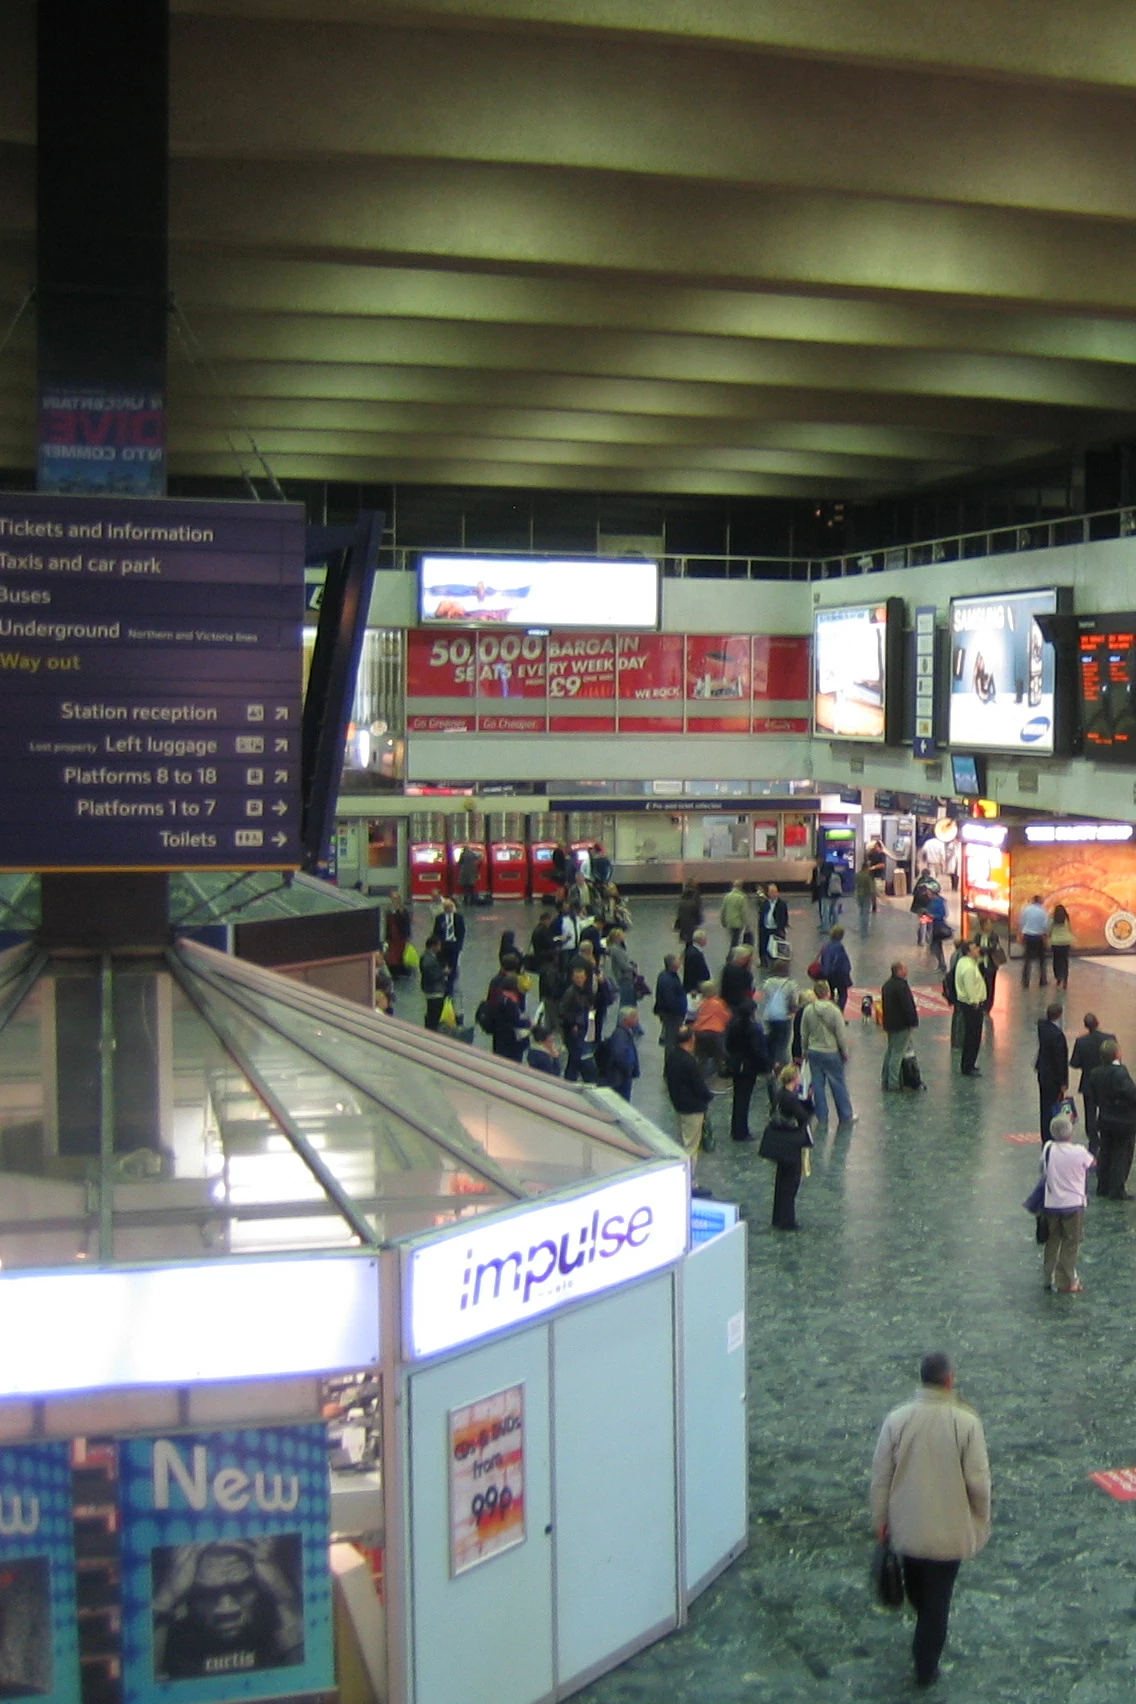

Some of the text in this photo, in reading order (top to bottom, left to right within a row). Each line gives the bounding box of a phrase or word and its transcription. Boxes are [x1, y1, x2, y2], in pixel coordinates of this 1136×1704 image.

[0, 518, 63, 537] Tickets
[68, 522, 102, 538] and
[0, 552, 162, 576] Taxis and car park
[0, 586, 51, 604] Buses
[0, 619, 120, 641] Underground
[430, 636, 640, 667] 50,000 BARGAIN
[0, 653, 81, 674] Way out
[455, 664, 512, 683] SEATS
[518, 661, 566, 679] EVERY
[550, 676, 581, 698] £9
[61, 702, 217, 723] Station reception
[106, 736, 142, 752] Left
[148, 737, 217, 756] luggage
[64, 767, 217, 784] Platforms 8 to 18
[78, 800, 217, 816] Platforms 1 to 7
[160, 831, 217, 847] Toilets
[460, 1206, 653, 1310] impulse
[153, 1439, 299, 1512] New
[473, 1452, 503, 1479] from
[472, 1484, 512, 1527] 99p
[205, 1651, 255, 1672] curtis
